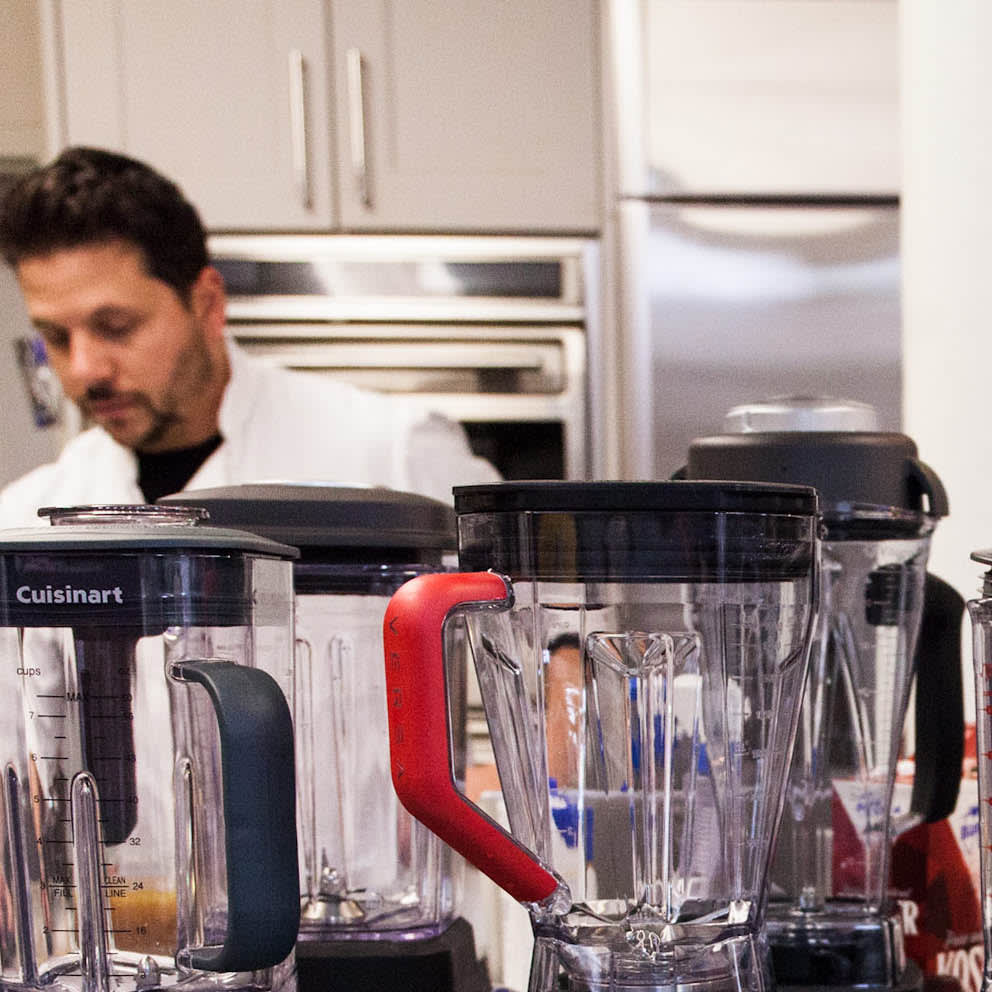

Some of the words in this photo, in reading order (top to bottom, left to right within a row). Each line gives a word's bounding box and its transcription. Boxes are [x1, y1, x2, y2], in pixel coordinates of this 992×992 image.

[16, 585, 124, 604] Cuisinart
[16, 667, 41, 677] cups
[29, 711, 34, 719] 7
[129, 837, 141, 846] 32
[132, 882, 144, 890] 24
[105, 889, 127, 897] LINE
[136, 927, 147, 935] 16
